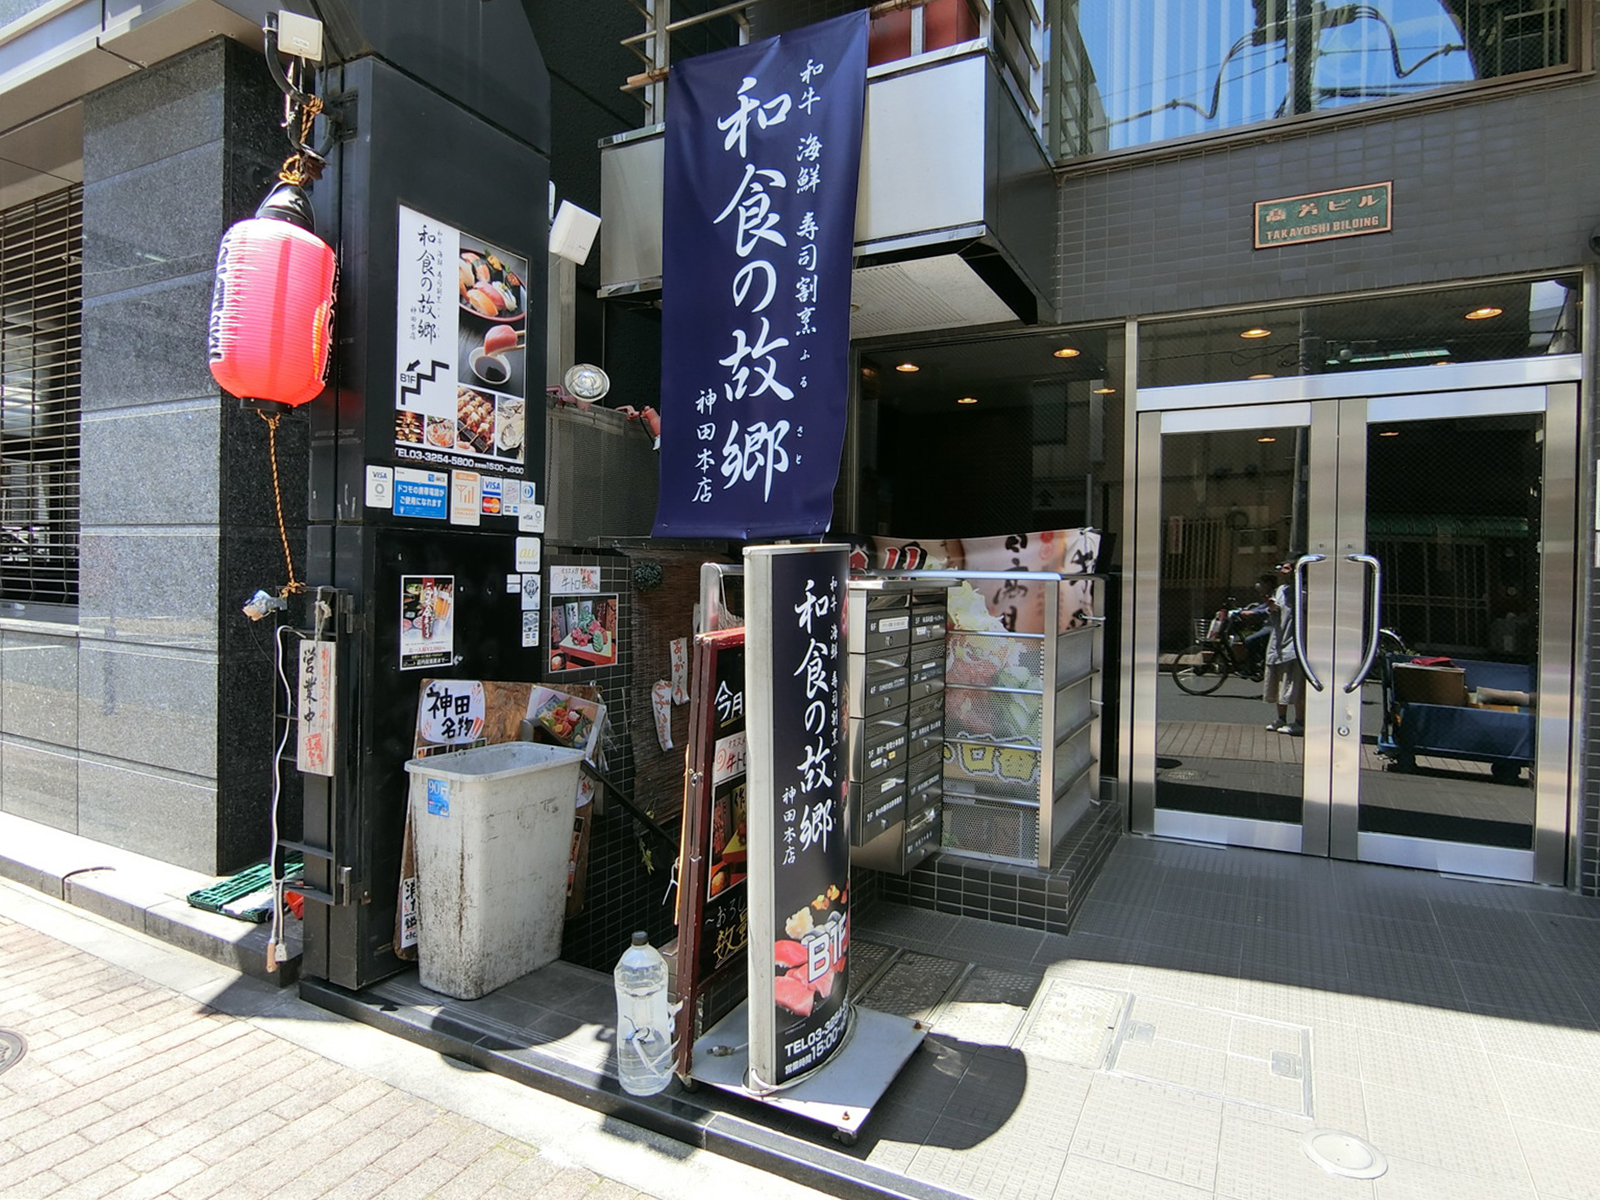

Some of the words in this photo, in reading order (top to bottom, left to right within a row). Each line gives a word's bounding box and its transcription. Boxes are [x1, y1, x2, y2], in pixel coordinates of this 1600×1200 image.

[798, 59, 824, 116] 和牛
[796, 133, 823, 194] 海鮮
[1266, 223, 1330, 241] TAKAYOSHI
[1333, 215, 1379, 232] BILDING
[416, 224, 437, 345] 和食の故郷
[713, 77, 795, 503] 和食の故郷
[795, 211, 820, 336] 寿司割烹
[400, 373, 417, 384] B1F
[691, 388, 718, 503] 神田本店
[372, 471, 388, 480] VISA
[484, 480, 501, 490] VISA
[518, 547, 538, 559] au
[303, 646, 318, 733] 営業中
[426, 687, 471, 720] 神田
[714, 680, 743, 722] 今月
[793, 579, 833, 853] 和食の故郷
[428, 780, 440, 795] 90
[781, 785, 797, 866] 神田本店
[808, 912, 847, 983] B1F
